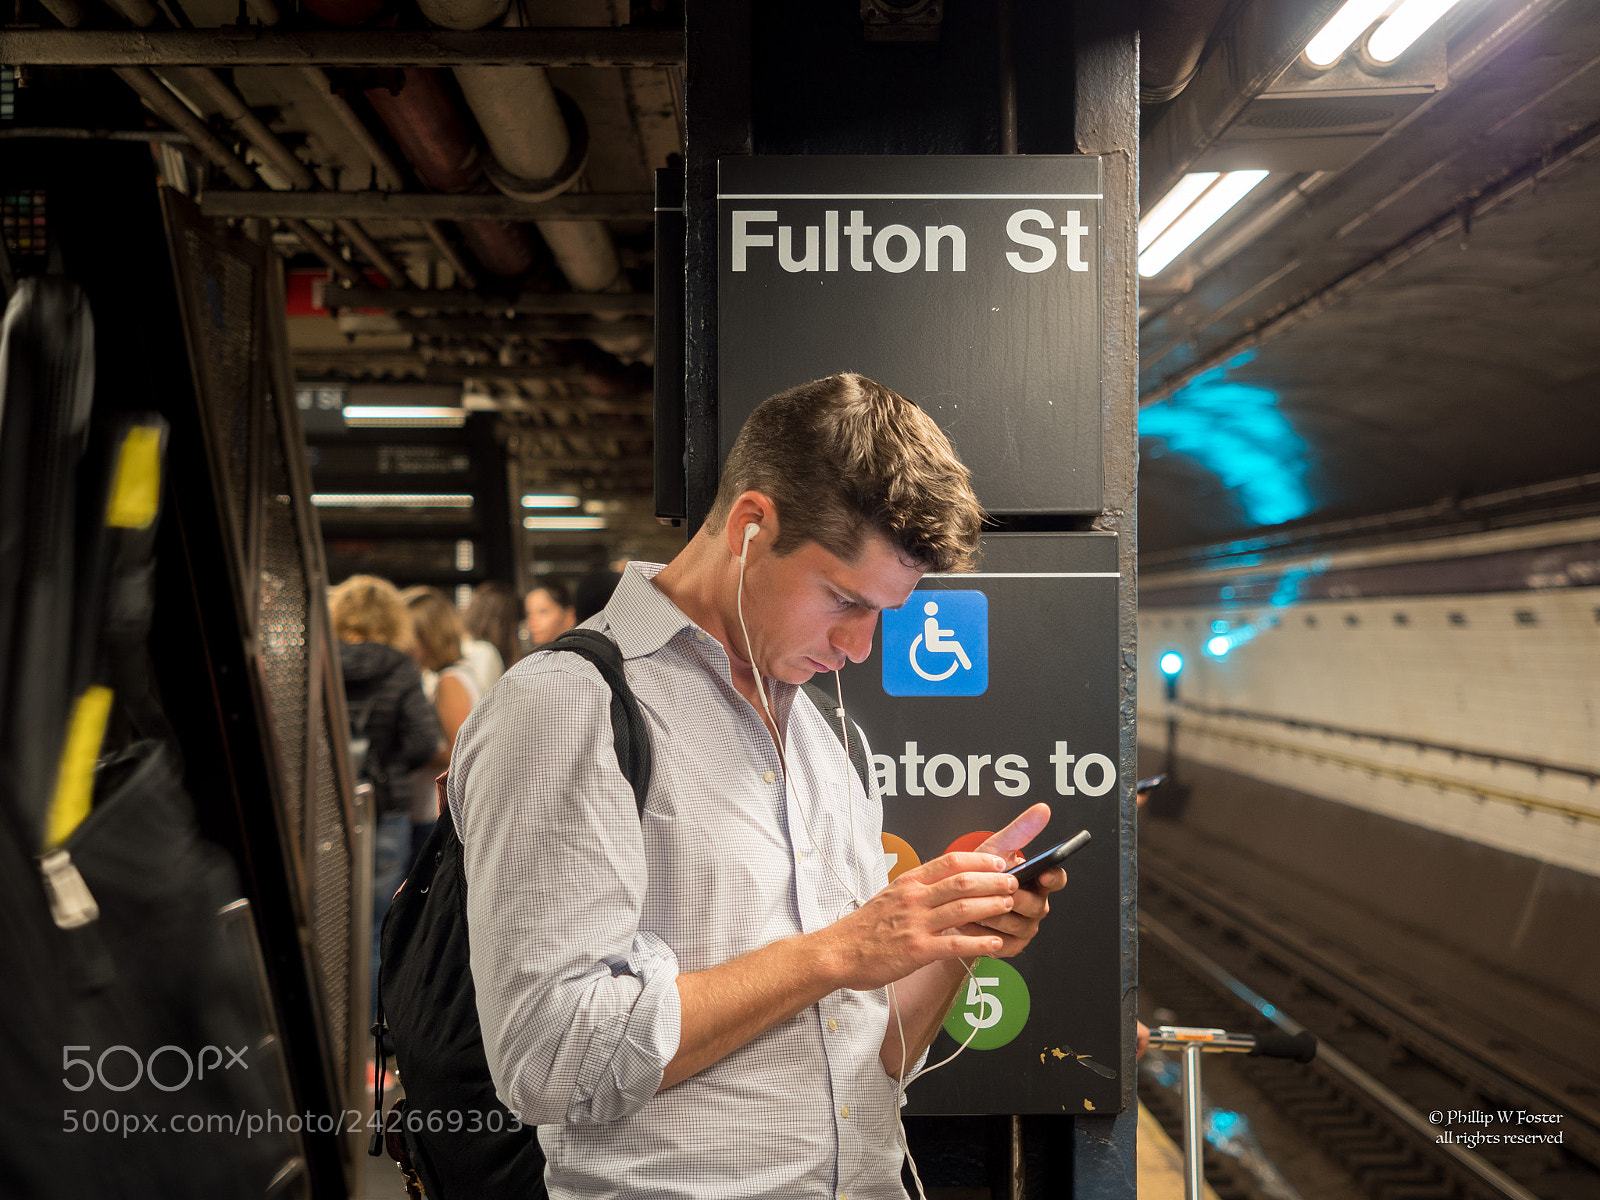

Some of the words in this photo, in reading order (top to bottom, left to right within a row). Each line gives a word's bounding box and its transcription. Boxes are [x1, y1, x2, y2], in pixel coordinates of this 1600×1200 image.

[731, 209, 967, 274] Fulton
[1005, 208, 1089, 274] St
[1049, 740, 1117, 798] to
[963, 977, 1003, 1029] 5
